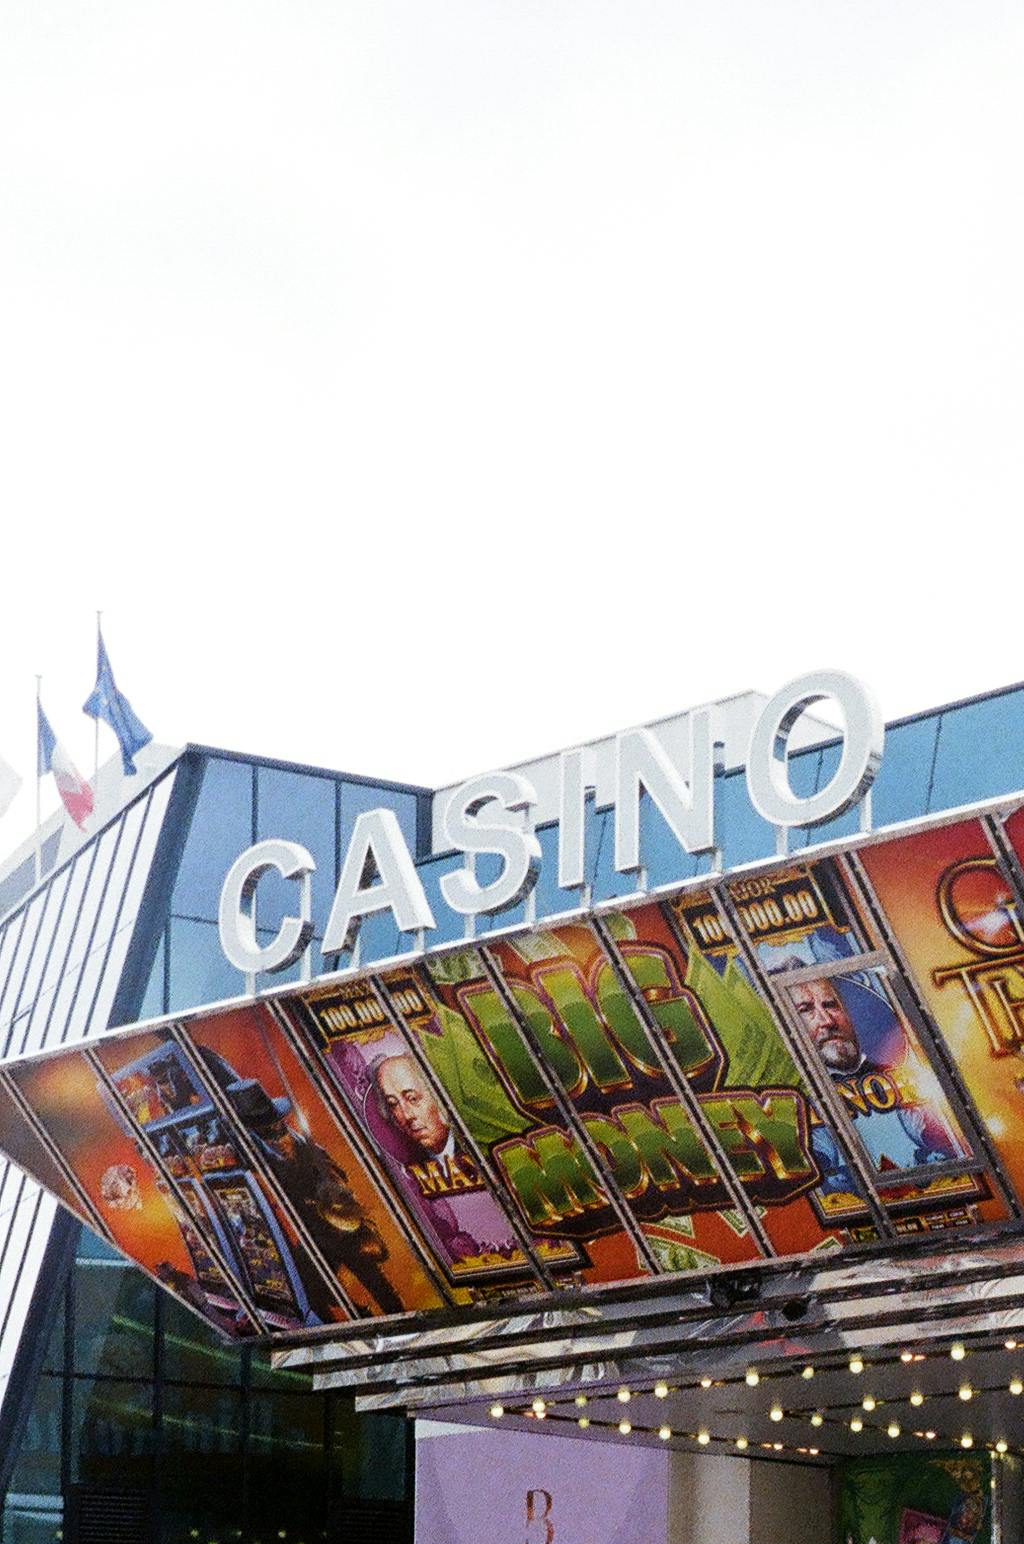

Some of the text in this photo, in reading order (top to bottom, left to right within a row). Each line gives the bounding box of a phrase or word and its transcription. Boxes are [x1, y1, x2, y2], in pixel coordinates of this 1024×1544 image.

[218, 667, 885, 974] CASINO
[458, 942, 726, 1108] BIG
[494, 1091, 817, 1230] MONEY
